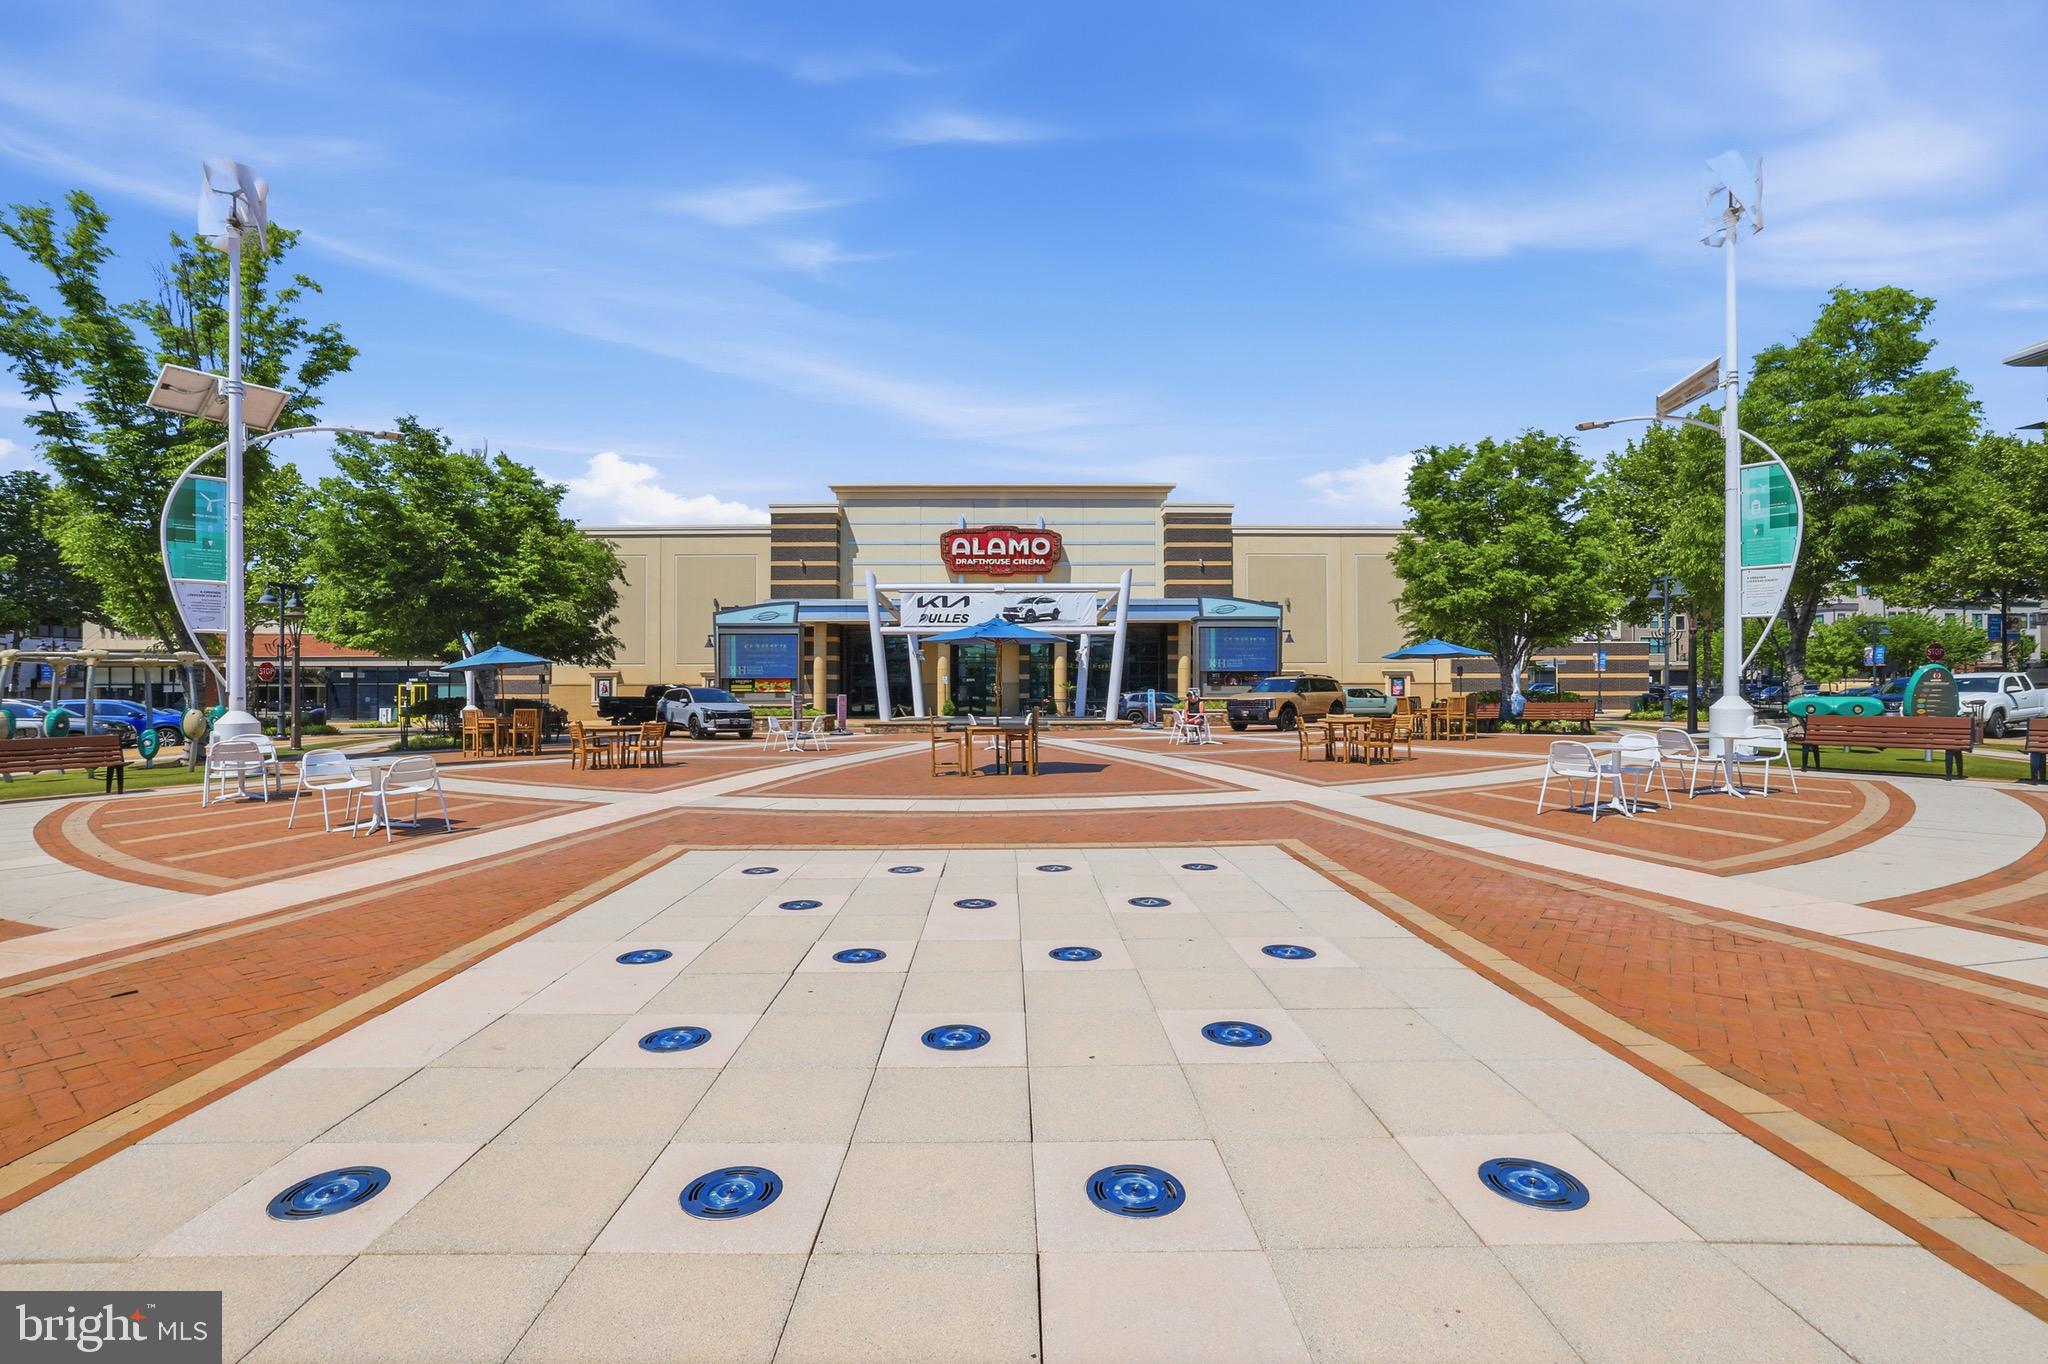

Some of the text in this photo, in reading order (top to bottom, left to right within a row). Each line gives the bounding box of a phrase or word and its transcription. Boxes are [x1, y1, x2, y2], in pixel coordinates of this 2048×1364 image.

[951, 537, 1051, 556] ALAMO
[955, 558, 1046, 566] DRAFTHOUSE CINEMA
[917, 595, 970, 608] KIA
[1927, 648, 1944, 656] STOP
[259, 667, 275, 675] STOP
